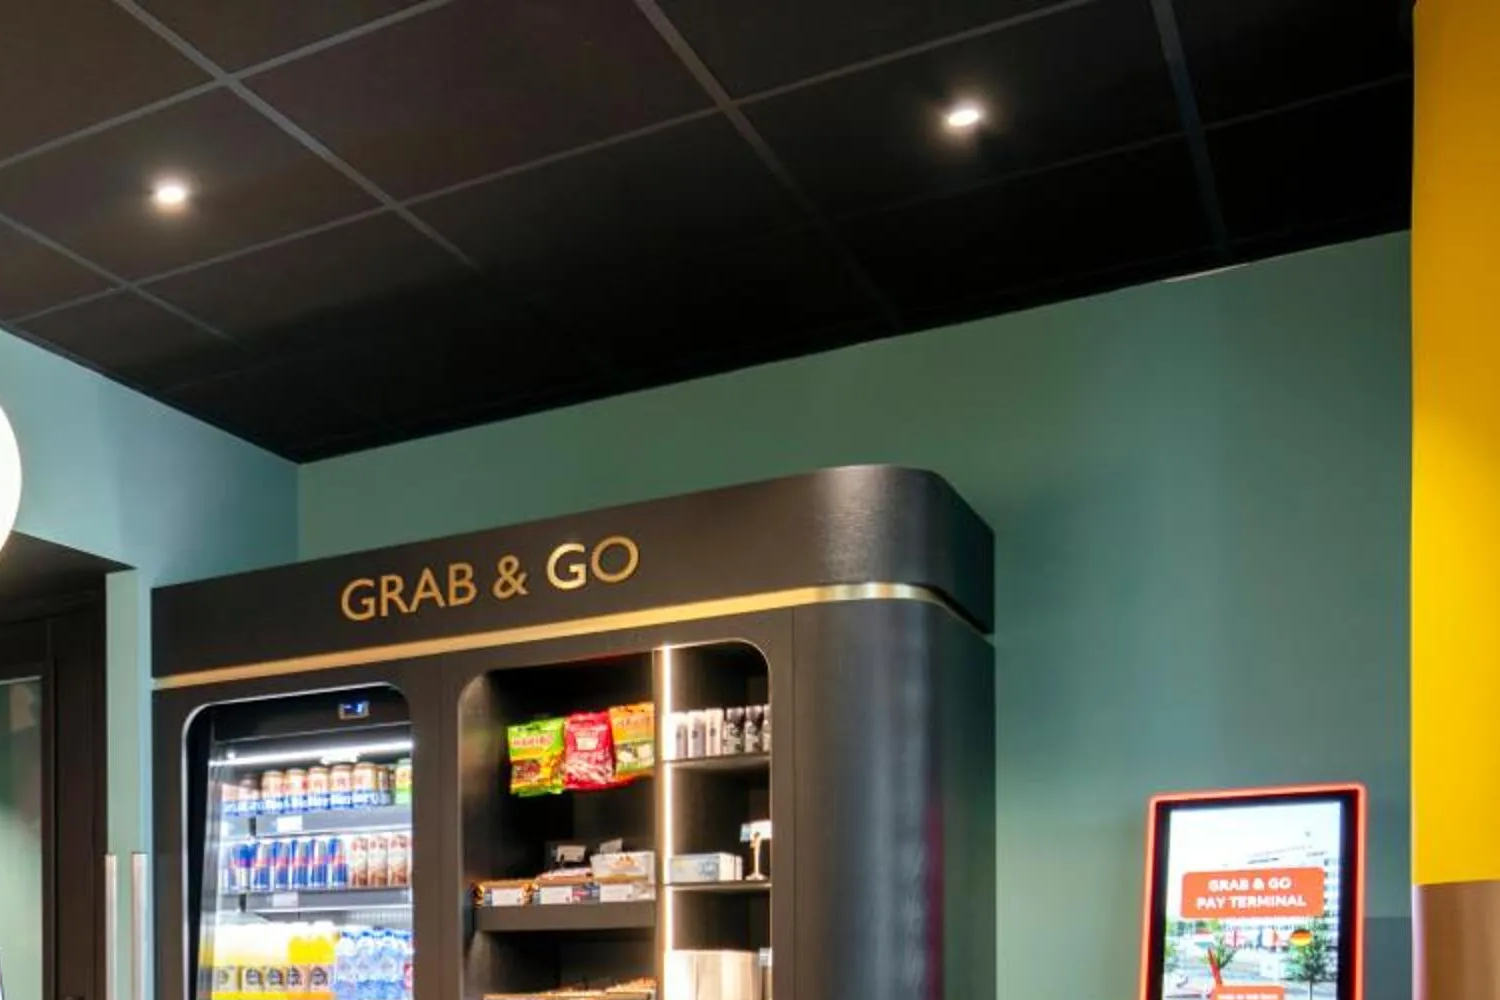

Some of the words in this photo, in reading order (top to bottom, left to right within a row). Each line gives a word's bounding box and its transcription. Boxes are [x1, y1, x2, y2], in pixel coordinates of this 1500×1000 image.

[341, 563, 477, 621] GRAB
[492, 554, 529, 599] &
[546, 535, 639, 591] GO
[1208, 878, 1249, 893] GRAB
[1252, 877, 1265, 891] &
[1267, 876, 1292, 890] GO
[1196, 897, 1226, 910] PAY
[1229, 894, 1307, 909] TERMINAL
